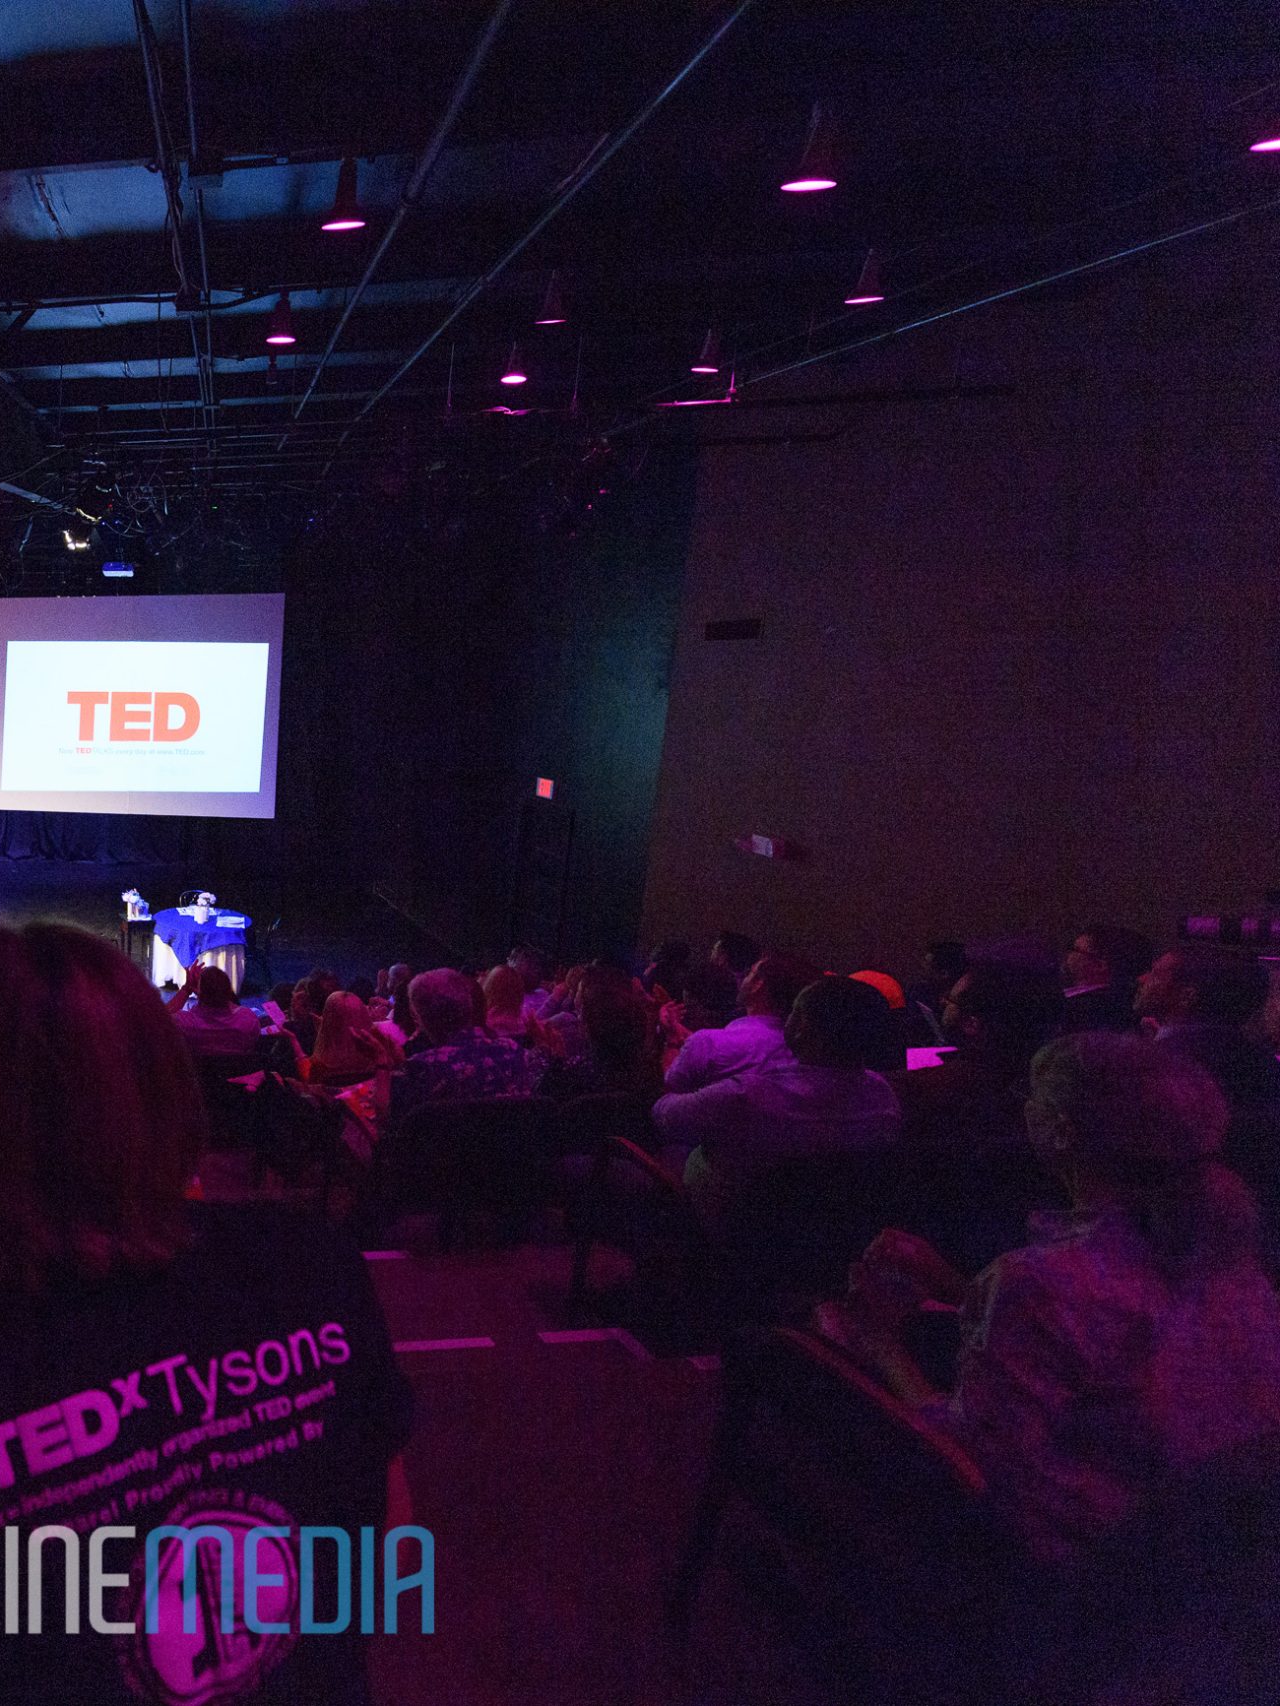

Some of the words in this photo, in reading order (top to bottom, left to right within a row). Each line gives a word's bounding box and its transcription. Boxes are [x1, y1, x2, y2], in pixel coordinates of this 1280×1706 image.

[67, 691, 201, 742] TED
[253, 1395, 292, 1423] TED
[208, 1426, 299, 1472] Powered
